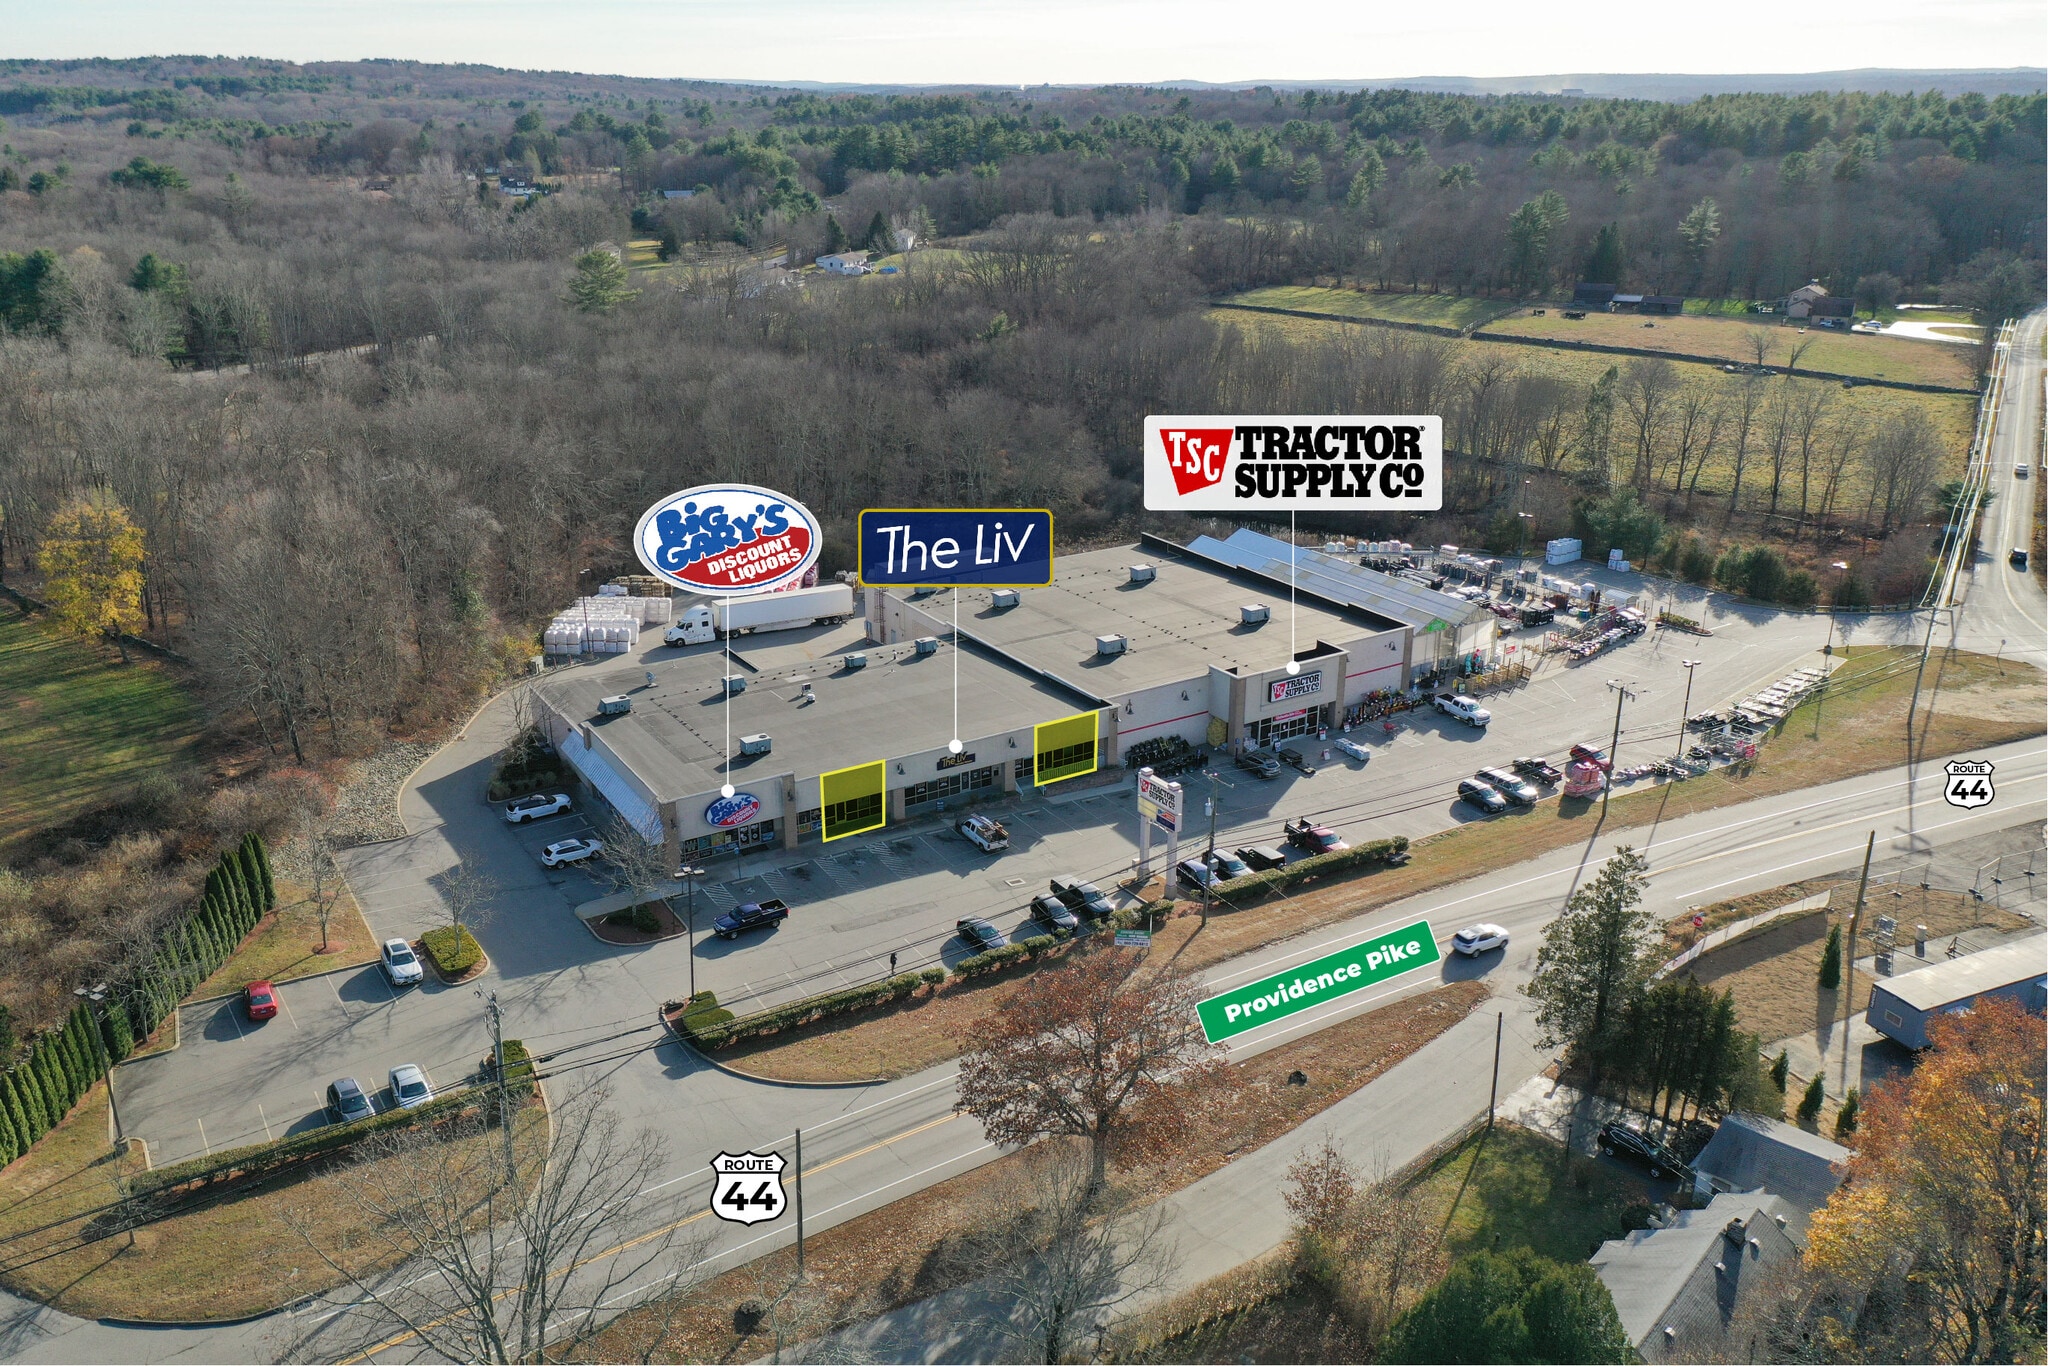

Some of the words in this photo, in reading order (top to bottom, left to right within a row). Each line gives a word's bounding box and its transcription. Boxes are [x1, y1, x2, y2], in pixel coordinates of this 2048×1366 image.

[1286, 674, 1320, 688] TRACTOR
[1285, 685, 1310, 698] SUPPLY
[941, 757, 956, 768] The
[1150, 782, 1176, 802] TRACTOR
